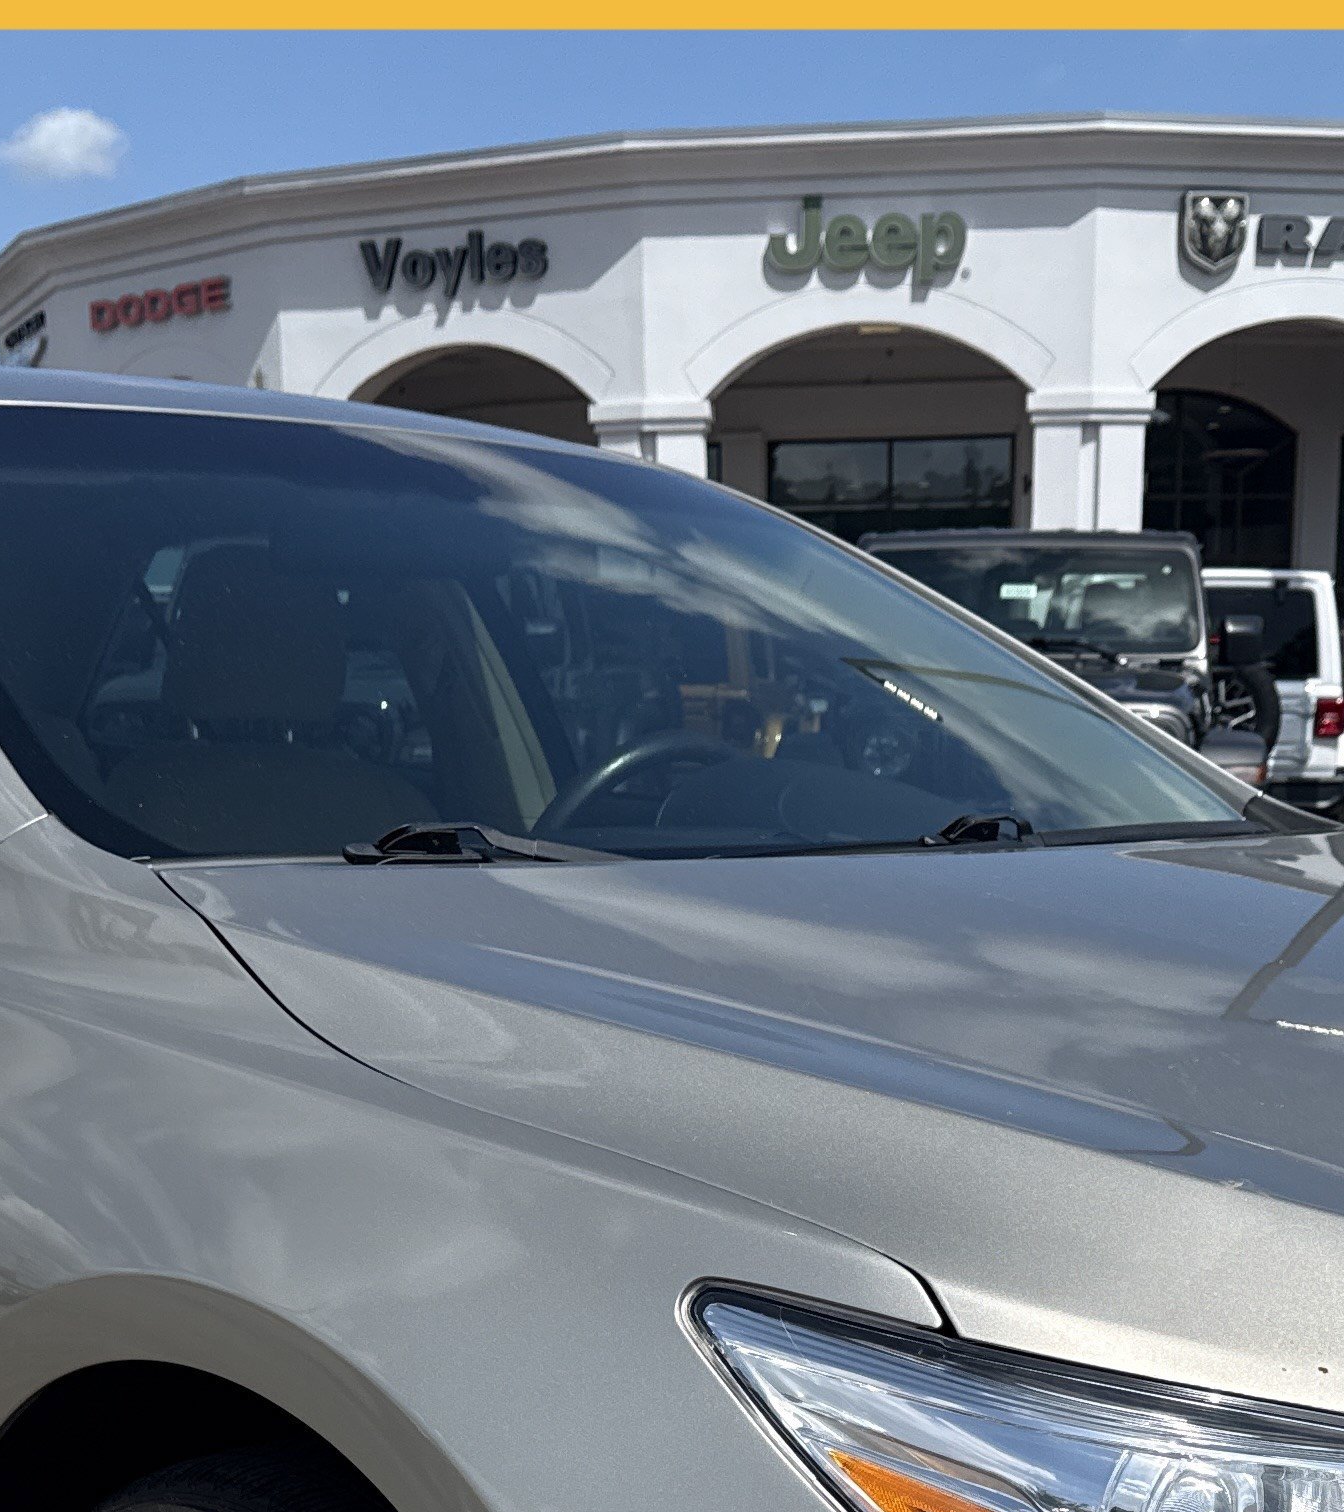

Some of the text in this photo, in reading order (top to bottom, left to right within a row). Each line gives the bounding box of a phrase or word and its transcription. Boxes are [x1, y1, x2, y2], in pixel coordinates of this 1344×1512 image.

[360, 230, 549, 300] Voyles
[765, 193, 966, 284] Jeep
[89, 275, 233, 334] DODGE
